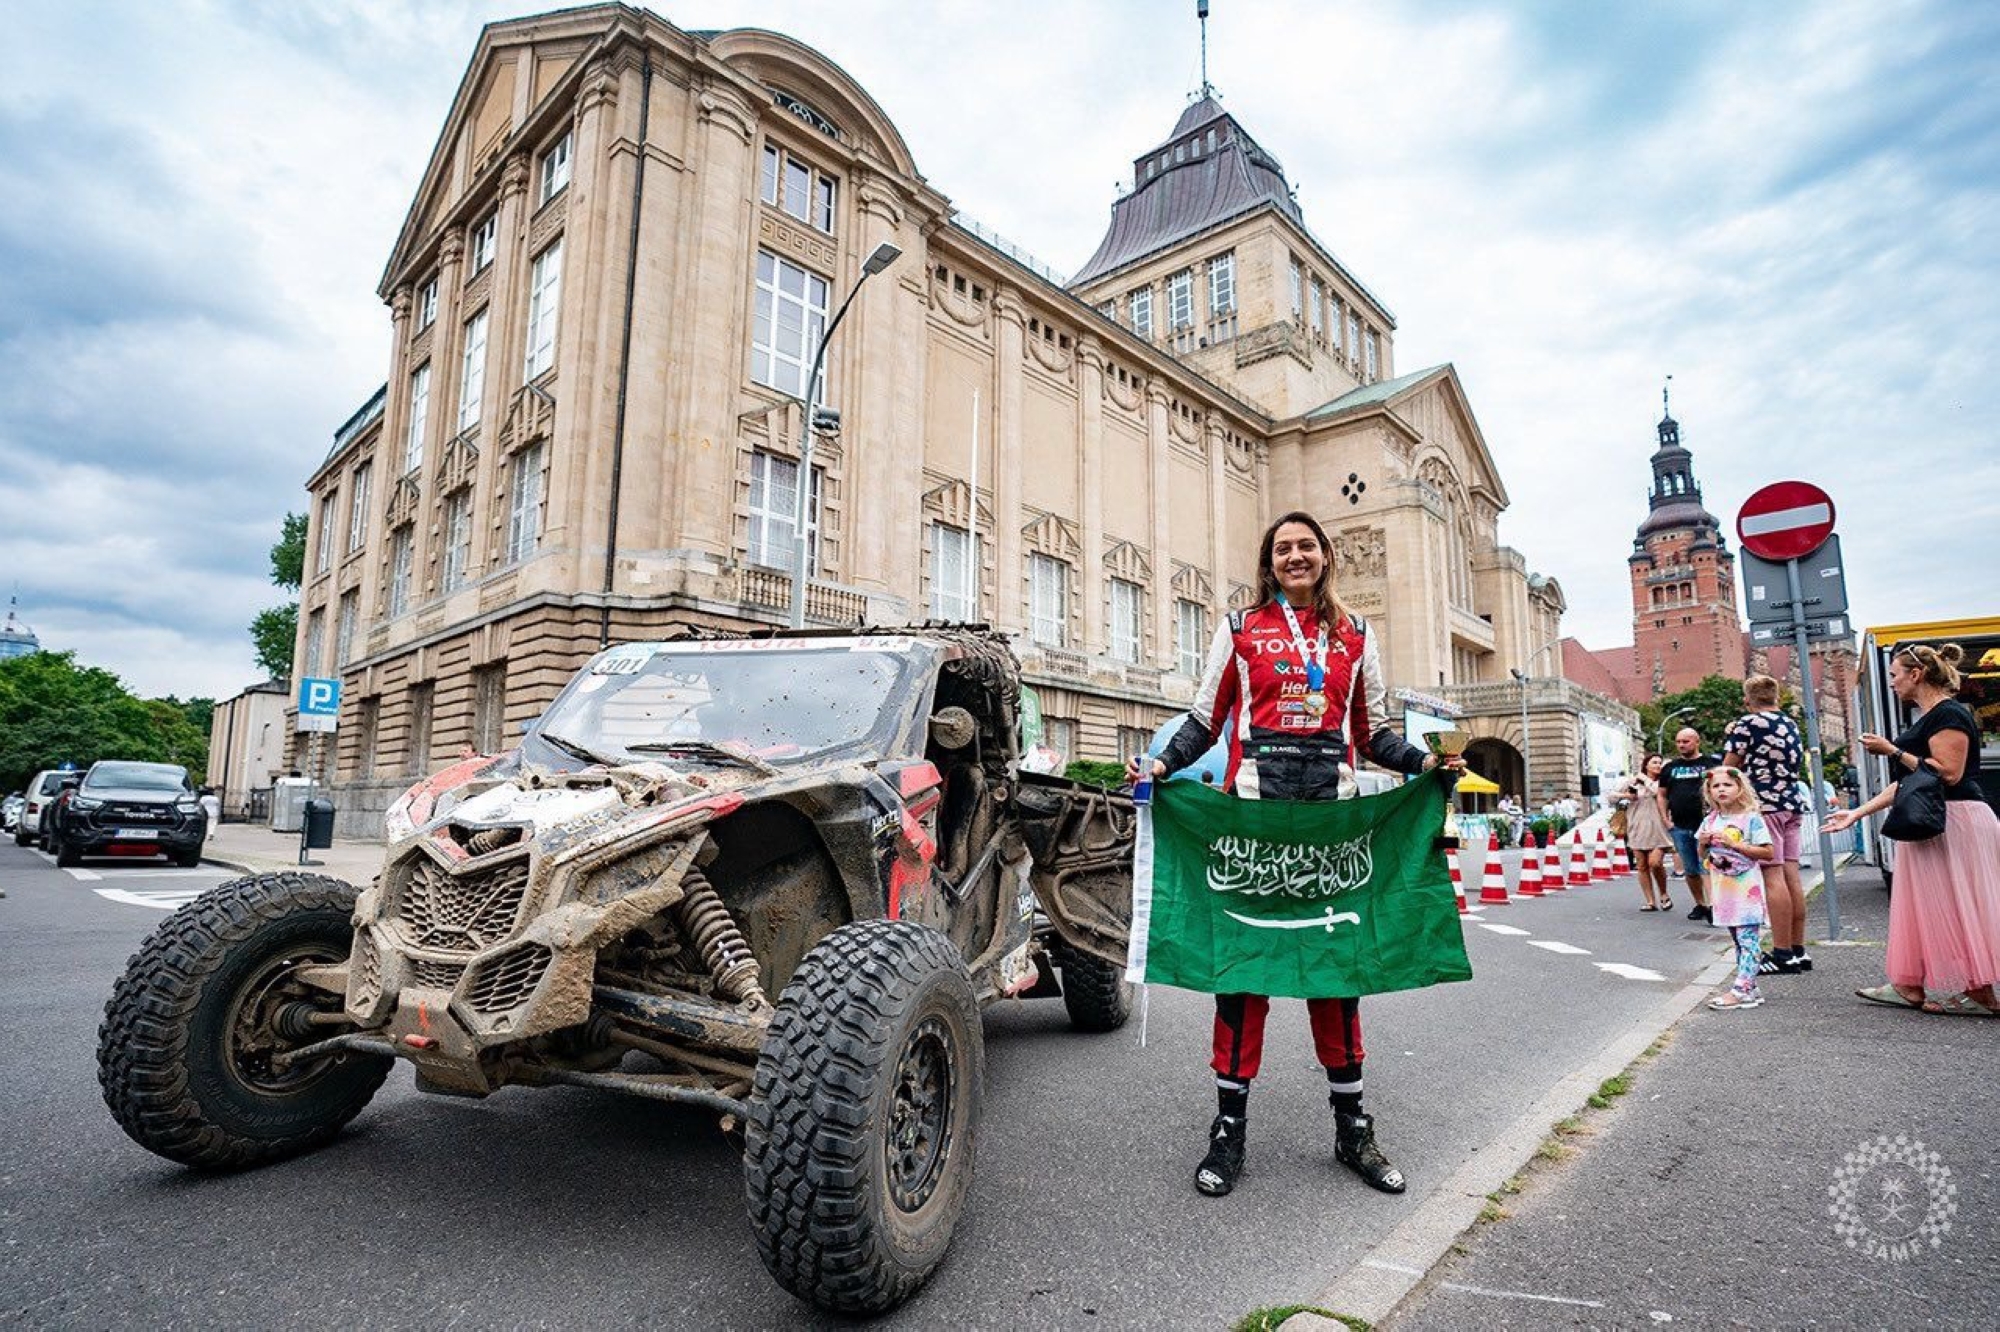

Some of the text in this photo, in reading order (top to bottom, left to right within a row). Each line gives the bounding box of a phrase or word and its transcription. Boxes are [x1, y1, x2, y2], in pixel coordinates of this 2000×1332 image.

[1251, 638, 1349, 657] TOYOA
[309, 682, 333, 709] P
[1281, 681, 1326, 694] Her
[124, 811, 156, 819] TOYOTA
